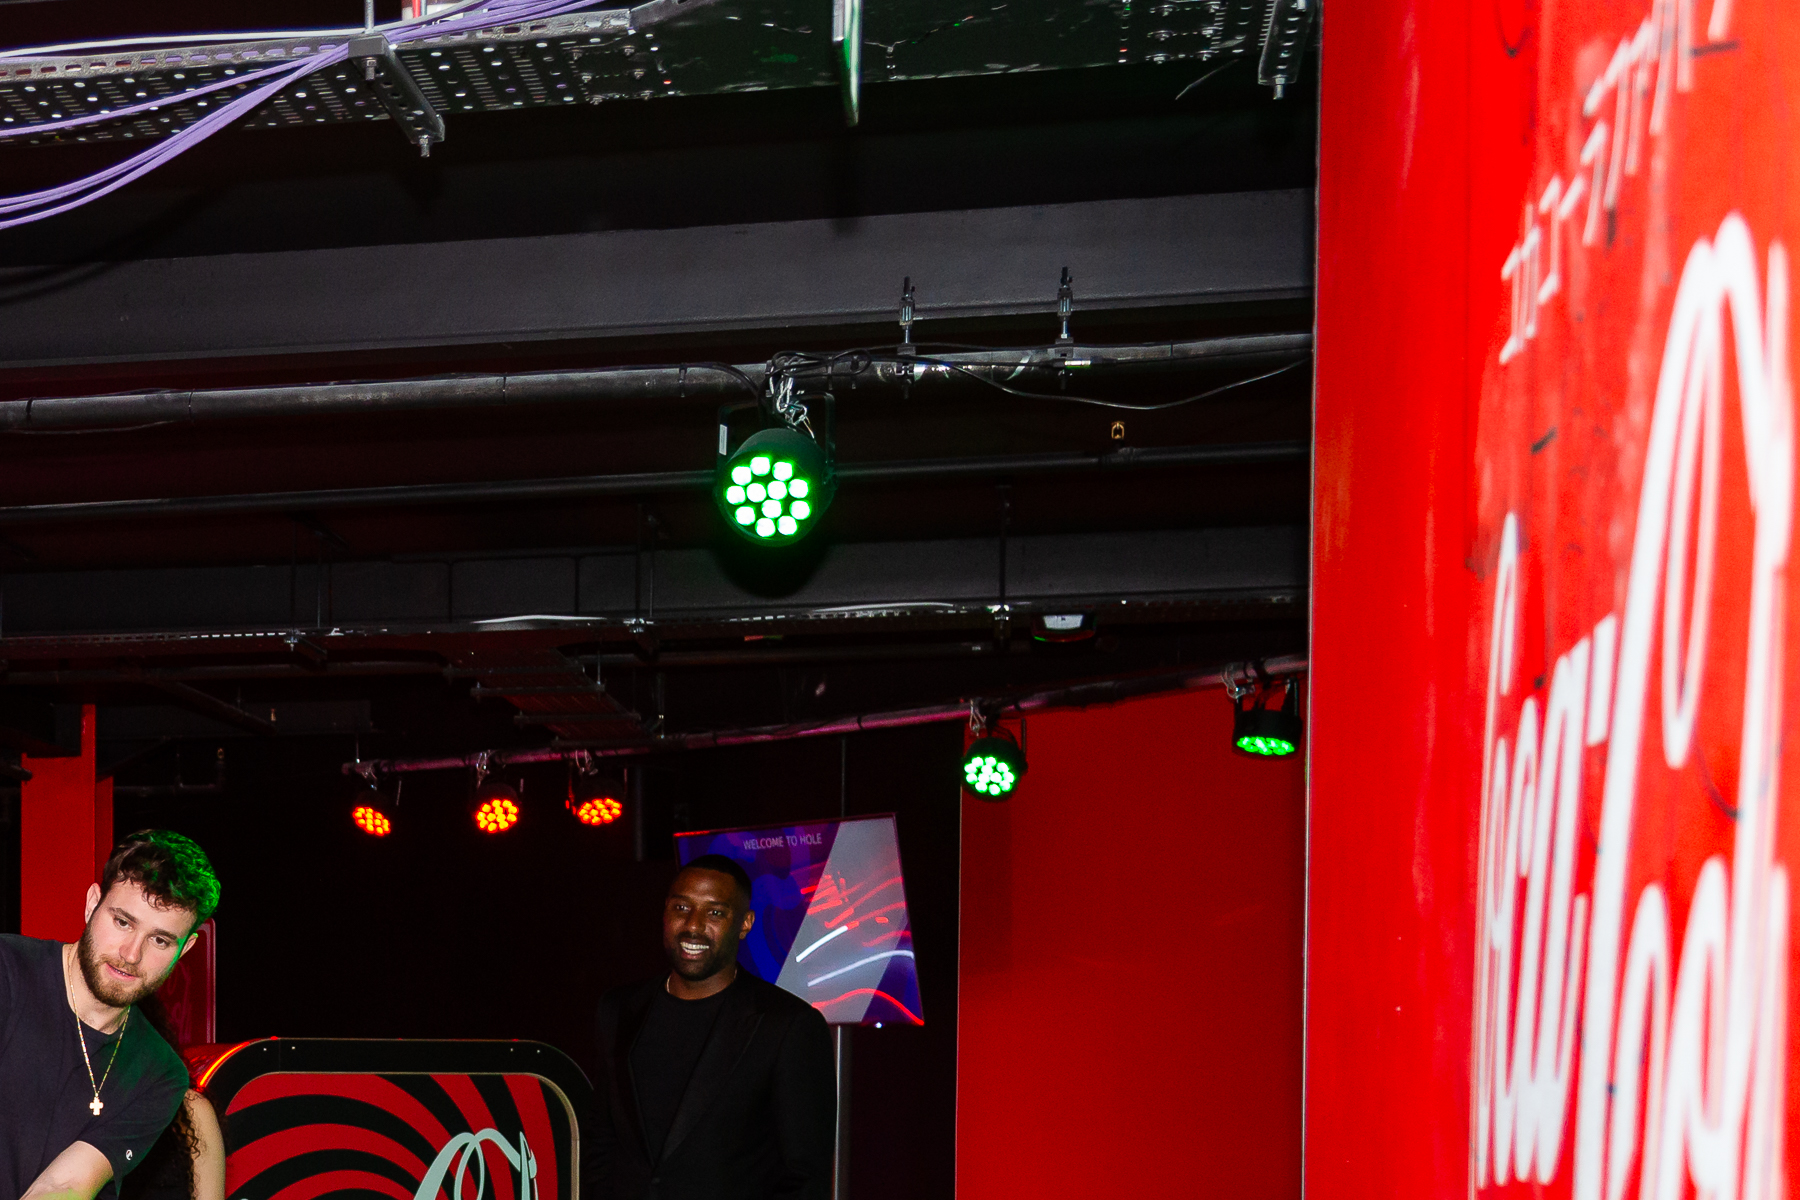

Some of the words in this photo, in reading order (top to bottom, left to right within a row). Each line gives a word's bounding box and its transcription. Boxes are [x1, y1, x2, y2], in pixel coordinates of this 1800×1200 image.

[743, 836, 784, 850] WELCOME
[786, 835, 798, 848] TO
[800, 833, 823, 846] HOLE
